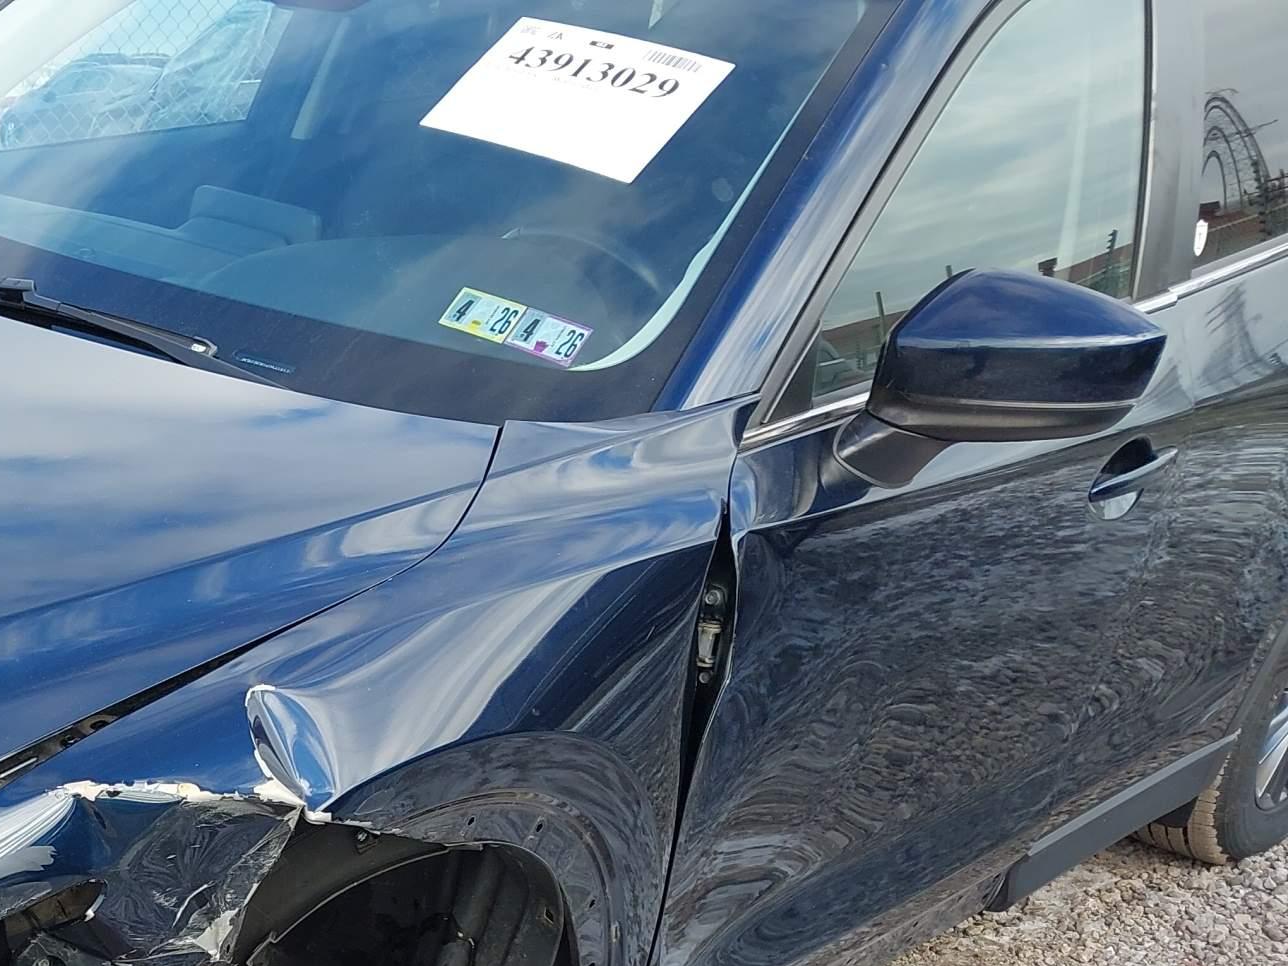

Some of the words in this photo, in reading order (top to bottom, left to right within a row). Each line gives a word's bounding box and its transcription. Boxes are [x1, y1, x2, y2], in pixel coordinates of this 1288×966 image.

[508, 45, 680, 98] 43913029
[455, 299, 475, 321] 4
[489, 307, 519, 335] 26
[522, 318, 541, 342] 4
[554, 329, 585, 358] 26
